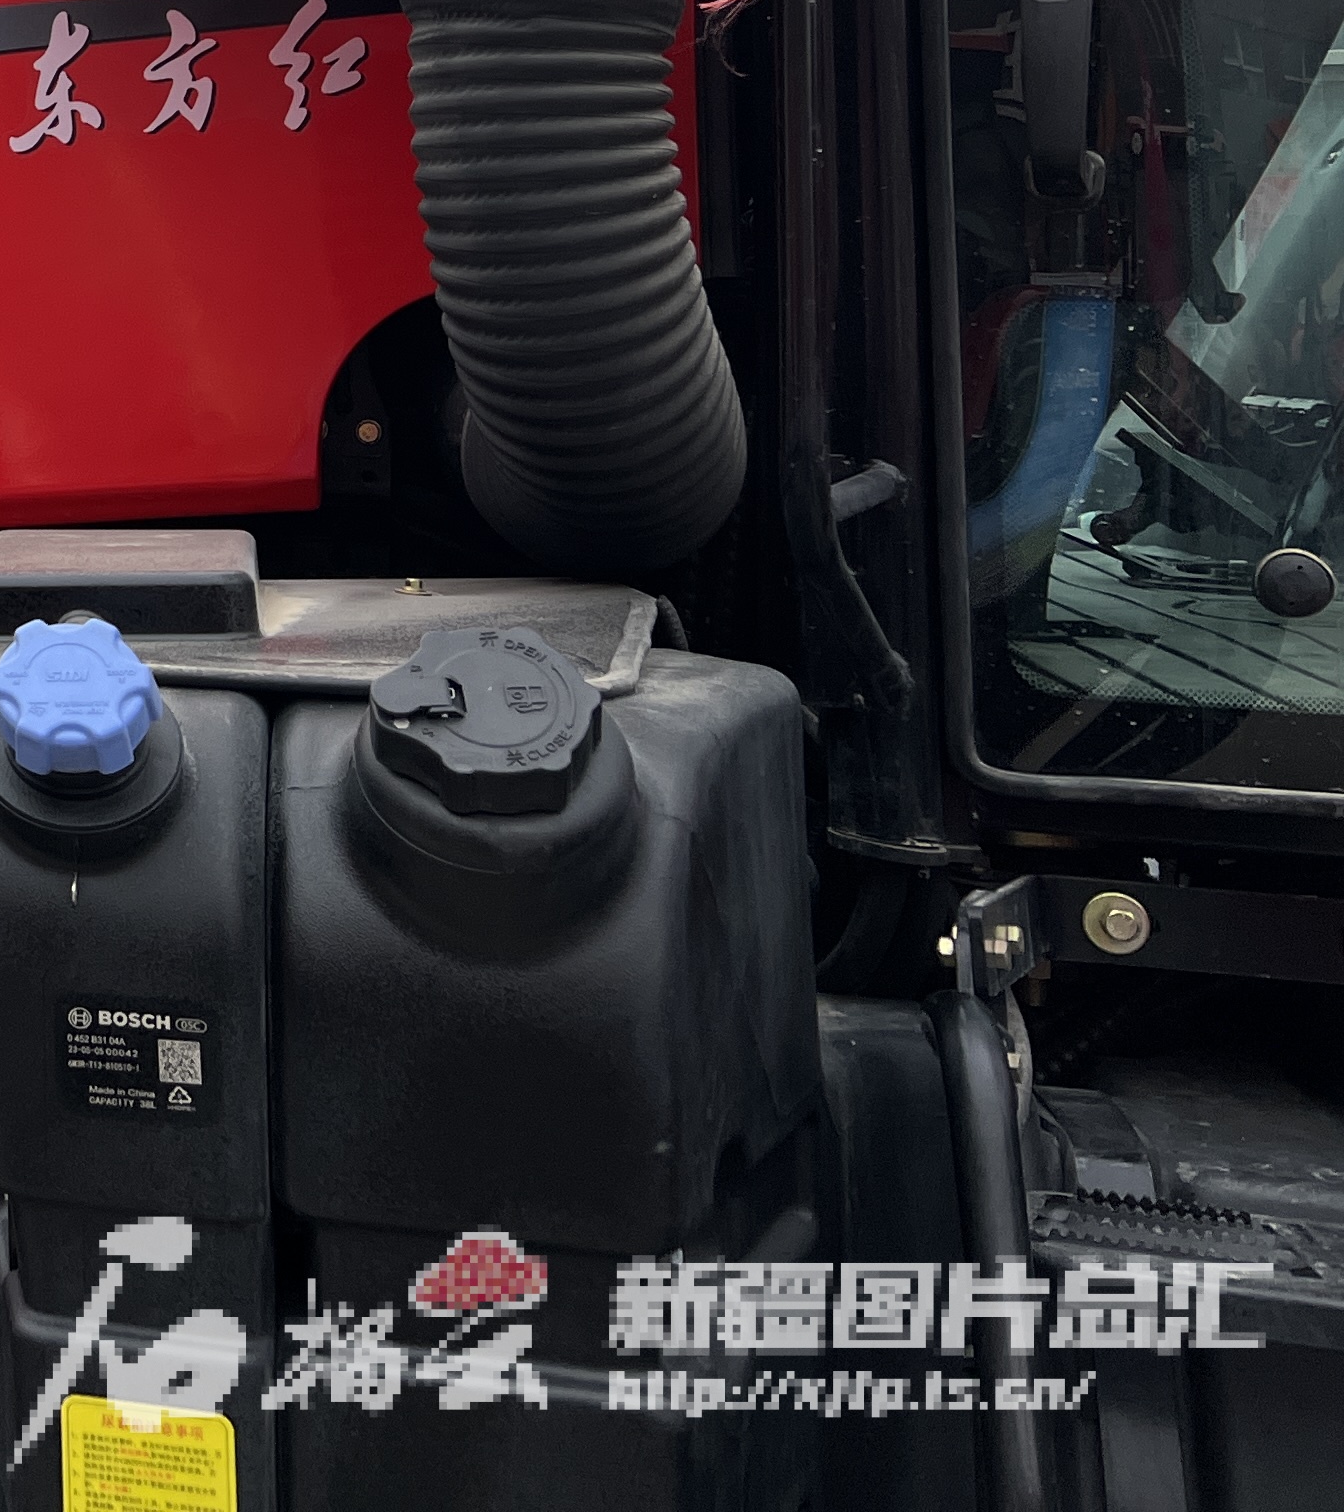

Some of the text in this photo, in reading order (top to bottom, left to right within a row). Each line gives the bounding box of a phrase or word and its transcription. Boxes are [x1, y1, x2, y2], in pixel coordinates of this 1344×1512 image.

[503, 639, 548, 663] OPEN
[526, 730, 574, 762] CLOSE
[98, 1009, 171, 1031] BOSCH
[88, 1096, 135, 1108] CAPACITY
[127, 1088, 156, 1099] China
